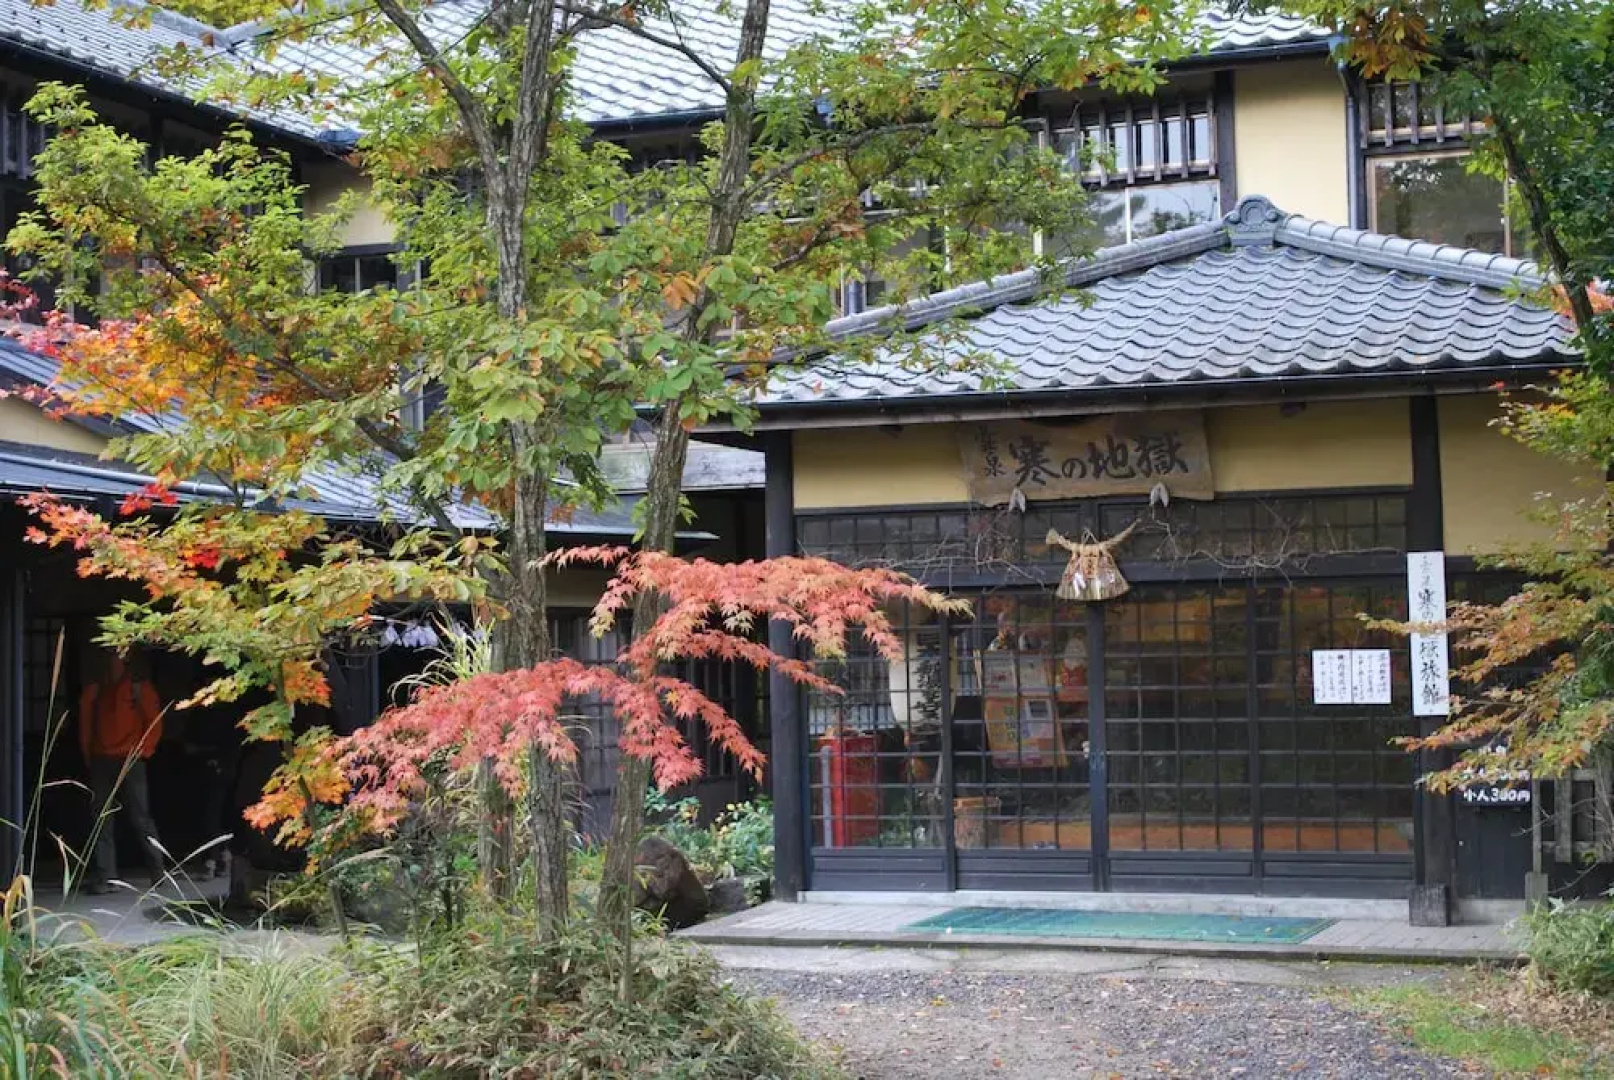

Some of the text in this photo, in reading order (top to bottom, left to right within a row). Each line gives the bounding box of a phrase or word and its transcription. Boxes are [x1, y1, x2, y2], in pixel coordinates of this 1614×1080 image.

[1008, 431, 1188, 487] 寒の地獄
[1418, 588, 1440, 706] 寒の獄旅館
